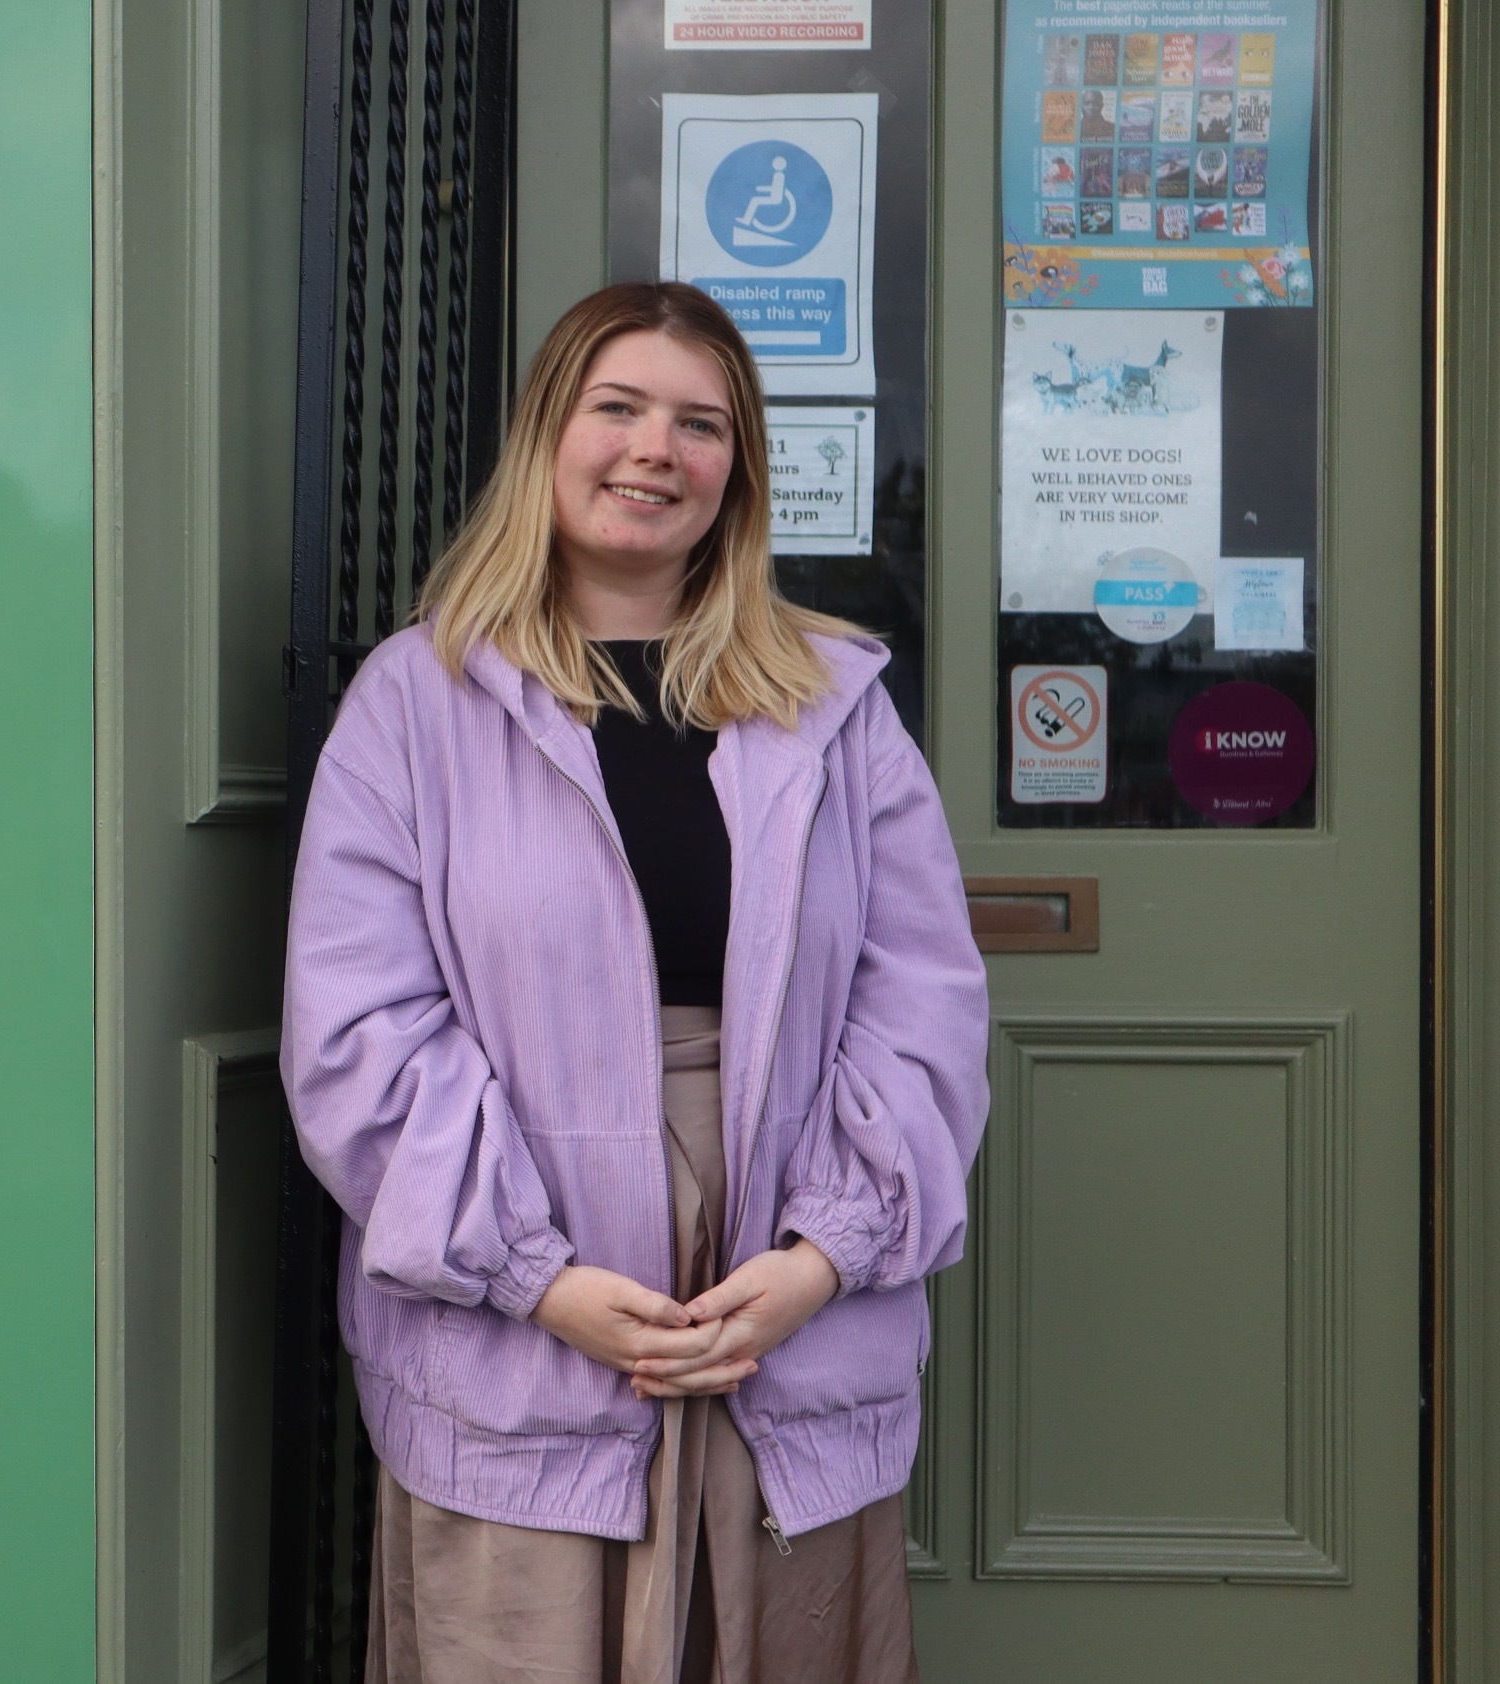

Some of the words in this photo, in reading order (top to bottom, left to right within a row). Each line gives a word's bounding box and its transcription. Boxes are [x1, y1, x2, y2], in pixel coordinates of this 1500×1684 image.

[1076, 0, 1101, 11] best
[1103, 0, 1159, 13] paperback
[1161, 0, 1190, 11] reads
[1035, 17, 1048, 26] as
[1050, 14, 1131, 27] recommended
[1133, 15, 1149, 29] by
[1151, 14, 1221, 29] independent
[1223, 14, 1288, 26] booksellers
[679, 27, 694, 38] 24
[697, 26, 734, 37] HOUR
[737, 26, 776, 37] VIDEO
[779, 26, 858, 38] RECORDING
[1237, 103, 1271, 120] GOLDEN
[709, 285, 780, 301] Disabled
[785, 287, 826, 305] ramp
[766, 306, 796, 321] this
[801, 308, 832, 324] way
[1042, 449, 1071, 462] WE
[1075, 449, 1122, 463] LOVE
[1127, 449, 1182, 463] DOGS!
[767, 463, 800, 475] ours
[1032, 472, 1073, 485] WELL
[1078, 473, 1147, 485] BEHAVED
[1152, 474, 1192, 486] ONES
[772, 488, 843, 504] Saturday
[1035, 491, 1064, 503] ARE
[1068, 491, 1107, 503] VERY
[1111, 492, 1188, 505] WELCOME
[778, 509, 788, 520] 4
[793, 511, 820, 524] pm
[1059, 510, 1075, 522] IN
[1080, 510, 1115, 522] THIS
[1119, 511, 1163, 523] SHOP.
[1125, 586, 1164, 601] PASS
[1217, 731, 1286, 750] KNOW
[1018, 758, 1036, 768] NO
[1040, 758, 1100, 769] SMOKING
